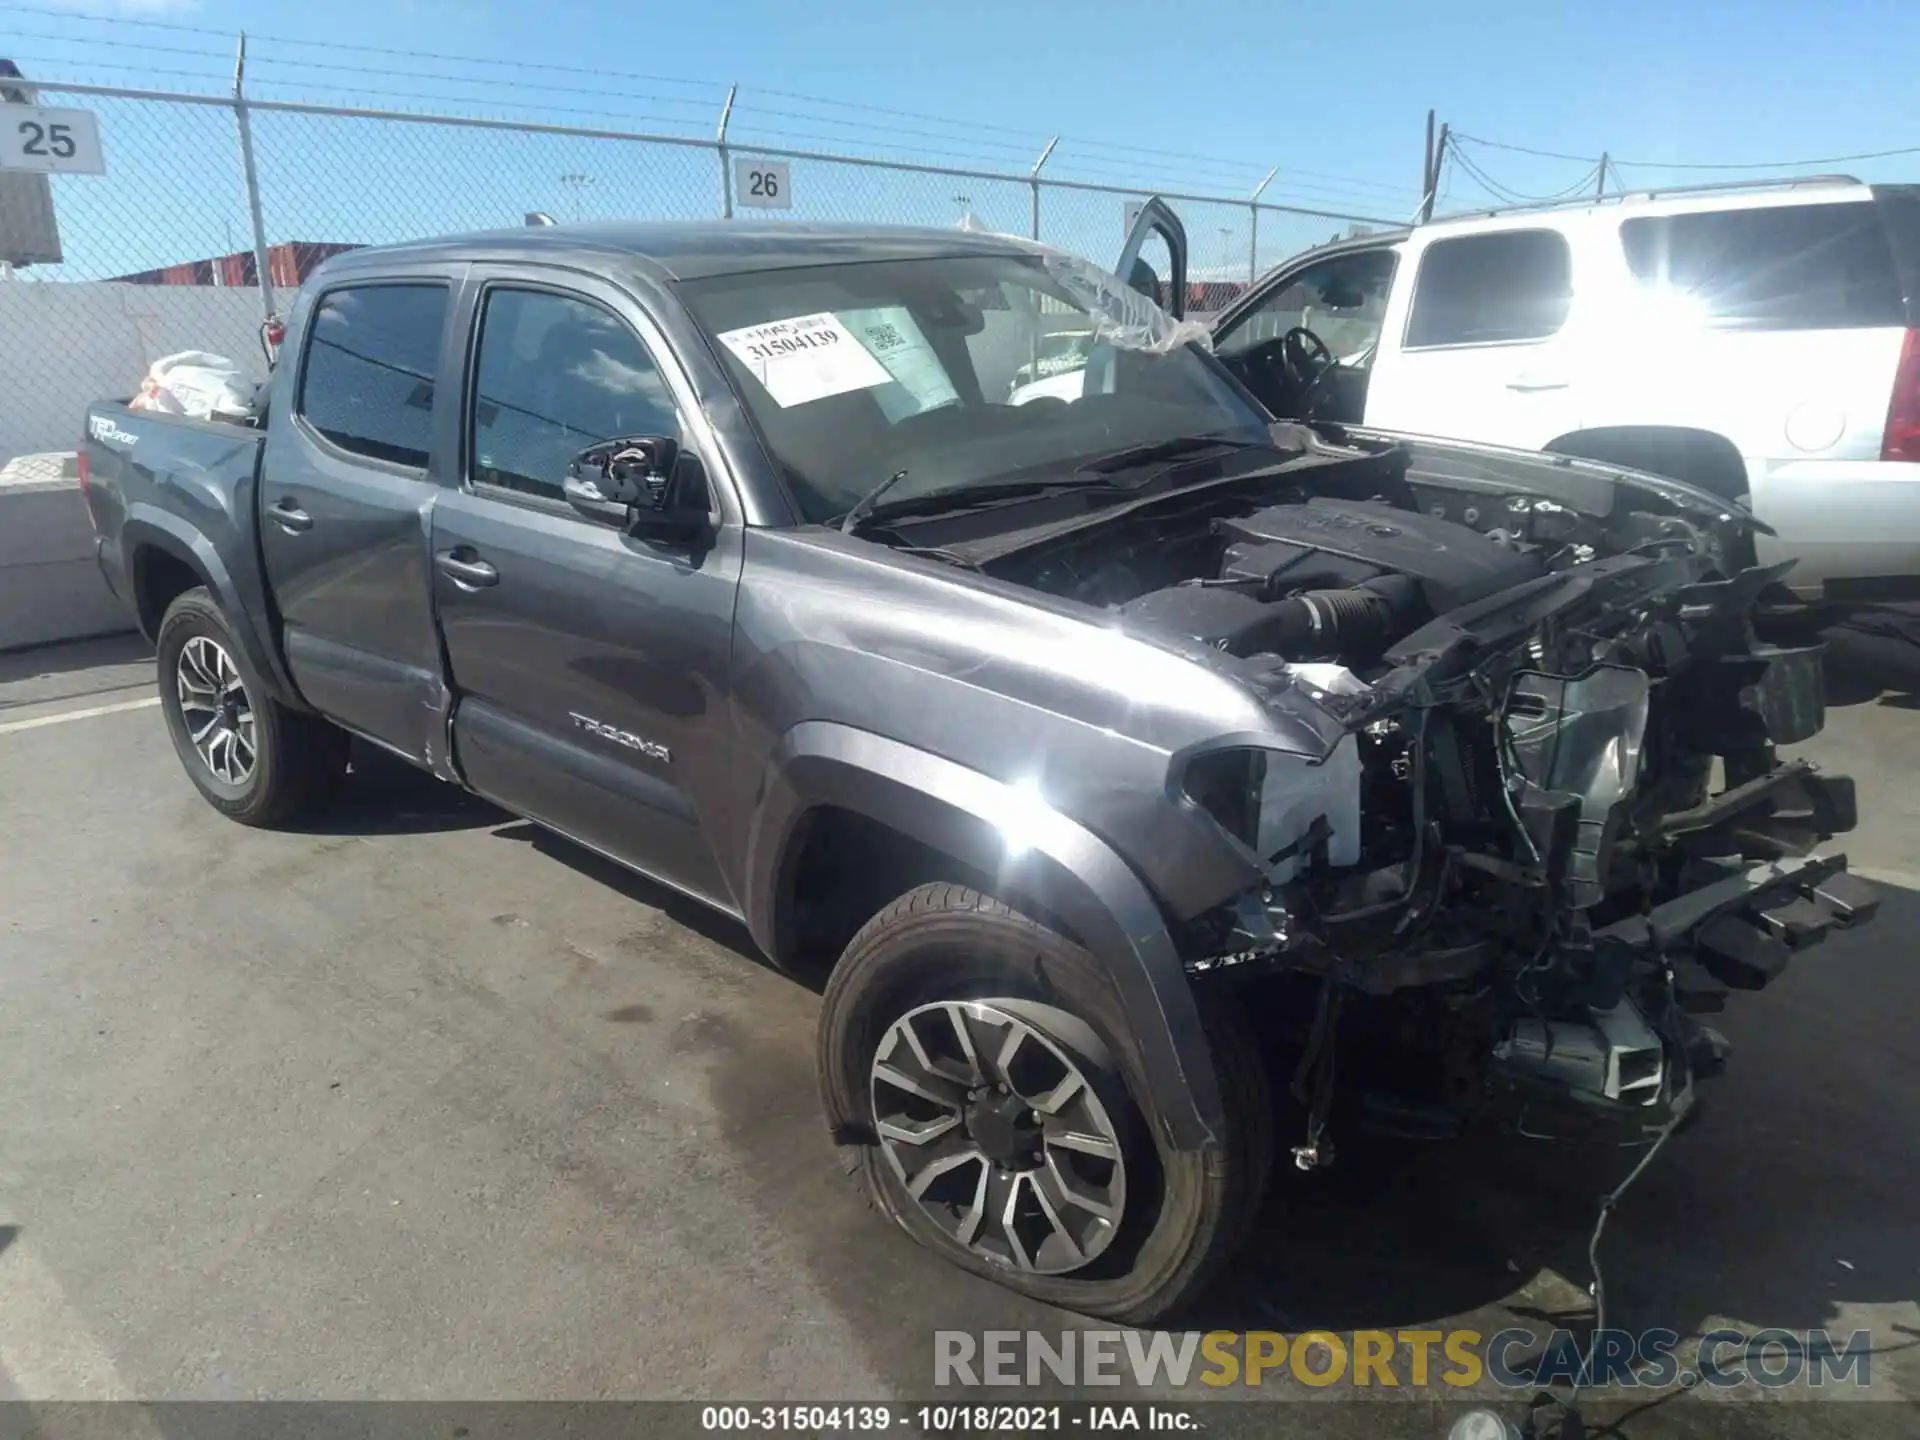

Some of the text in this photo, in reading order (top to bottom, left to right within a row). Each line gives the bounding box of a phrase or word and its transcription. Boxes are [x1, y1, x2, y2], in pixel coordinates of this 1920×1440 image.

[18, 121, 77, 158] 25
[750, 171, 778, 197] 26
[747, 329, 839, 361] 31504139
[568, 711, 671, 764] TACOMA
